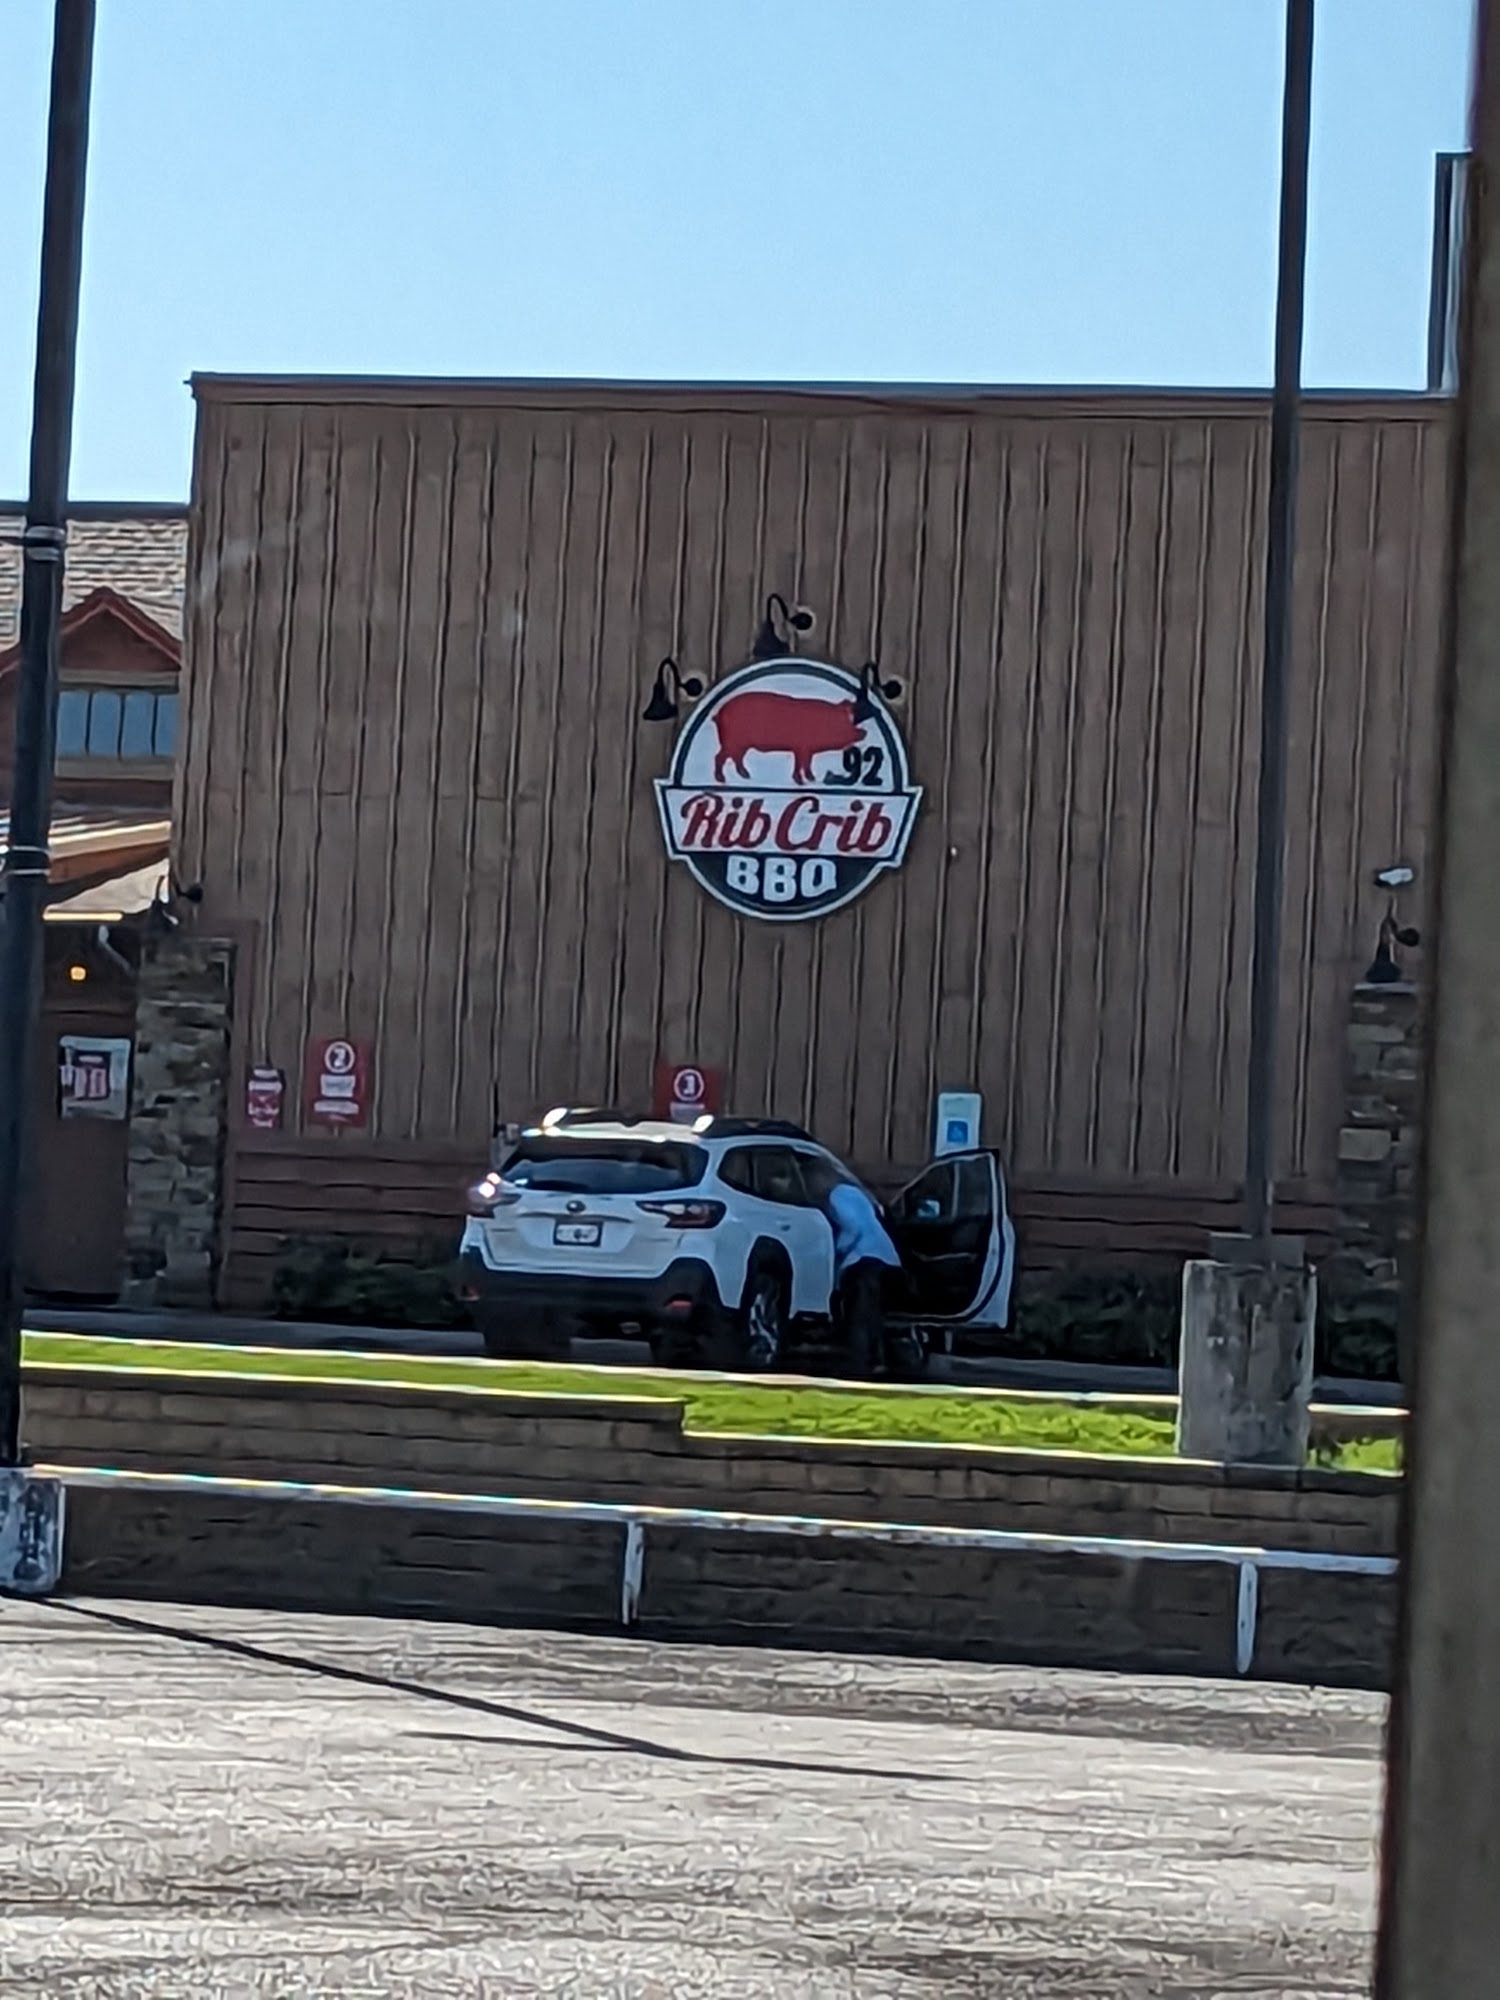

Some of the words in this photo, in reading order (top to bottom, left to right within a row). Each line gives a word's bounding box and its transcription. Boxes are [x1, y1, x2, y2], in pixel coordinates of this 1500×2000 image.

[824, 745, 885, 787] 92
[726, 855, 837, 902] BBQ
[333, 1047, 346, 1068] 2
